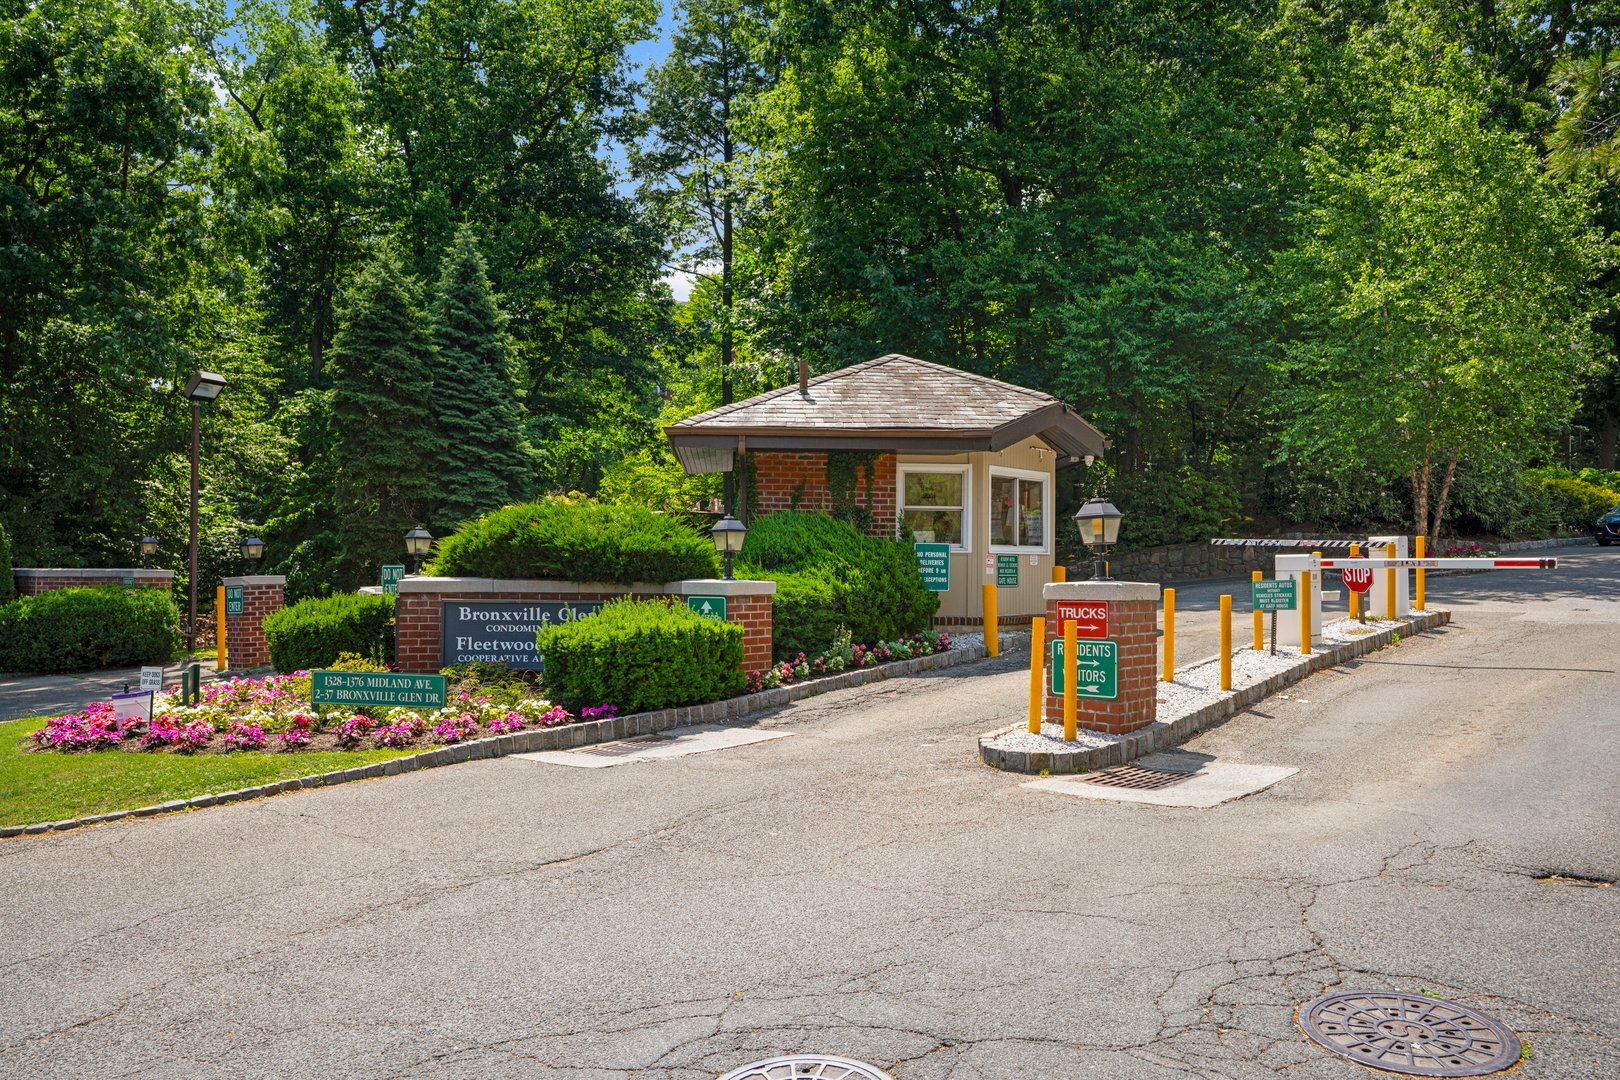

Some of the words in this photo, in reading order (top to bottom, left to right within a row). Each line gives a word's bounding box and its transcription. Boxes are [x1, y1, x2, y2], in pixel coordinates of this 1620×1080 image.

[1345, 568, 1370, 583] STOP
[229, 601, 241, 611] ENTER
[1059, 607, 1106, 619] TRUCKS
[459, 606, 551, 621] Bronxville
[457, 655, 529, 663] COOPERATIVE
[324, 676, 365, 687] 1328-1376
[367, 678, 412, 689] MIDLAND
[414, 680, 433, 690] AVE.
[315, 689, 334, 699] 2-37
[336, 690, 396, 702] BRONXVILLE
[398, 692, 423, 703] GLEN
[425, 693, 441, 704] DR.
